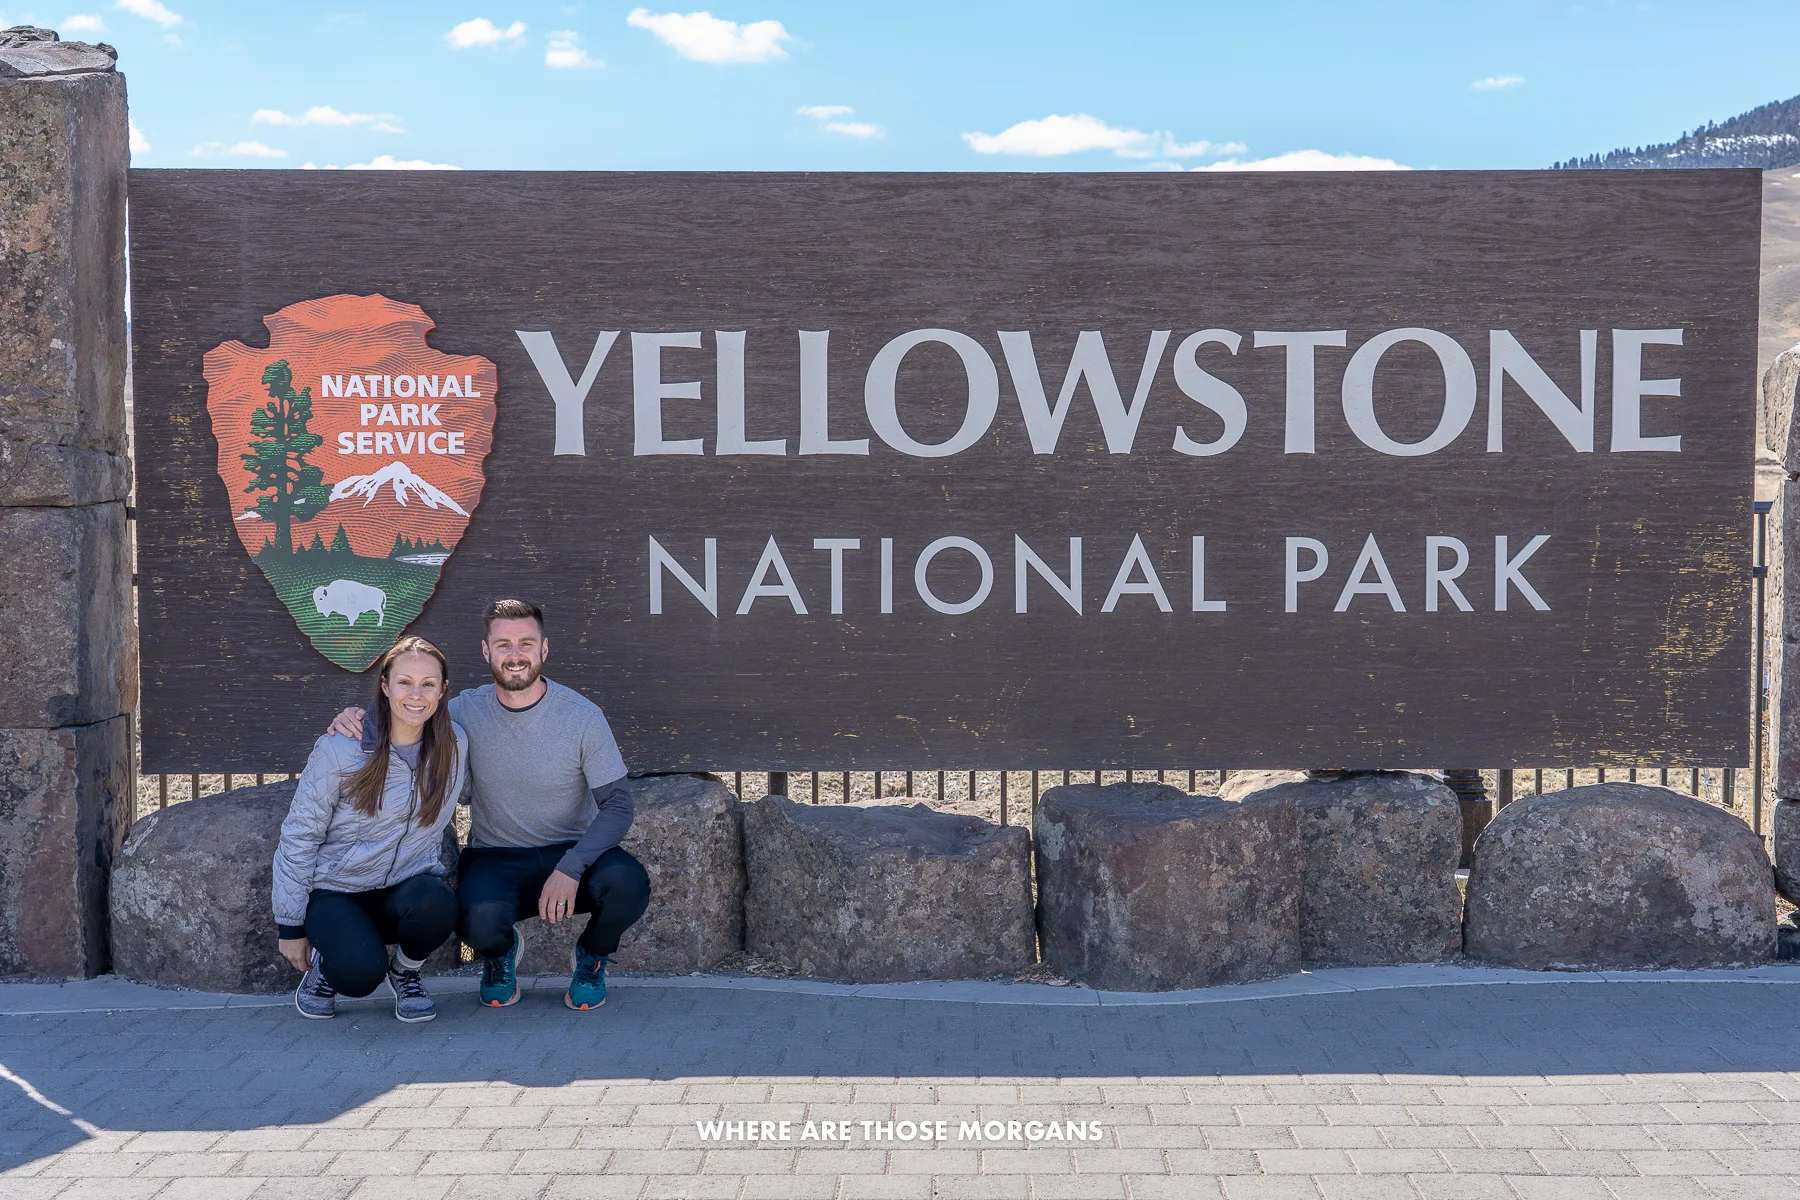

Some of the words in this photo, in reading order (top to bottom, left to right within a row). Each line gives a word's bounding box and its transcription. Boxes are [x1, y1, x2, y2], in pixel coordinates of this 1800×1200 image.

[321, 374, 481, 398] NATIONAL
[514, 327, 1684, 458] YELLOWSTONE
[360, 403, 442, 426] PARK
[337, 431, 466, 455] SERVICE
[649, 532, 1227, 618] NATIONAL
[1285, 532, 1552, 613] PARK
